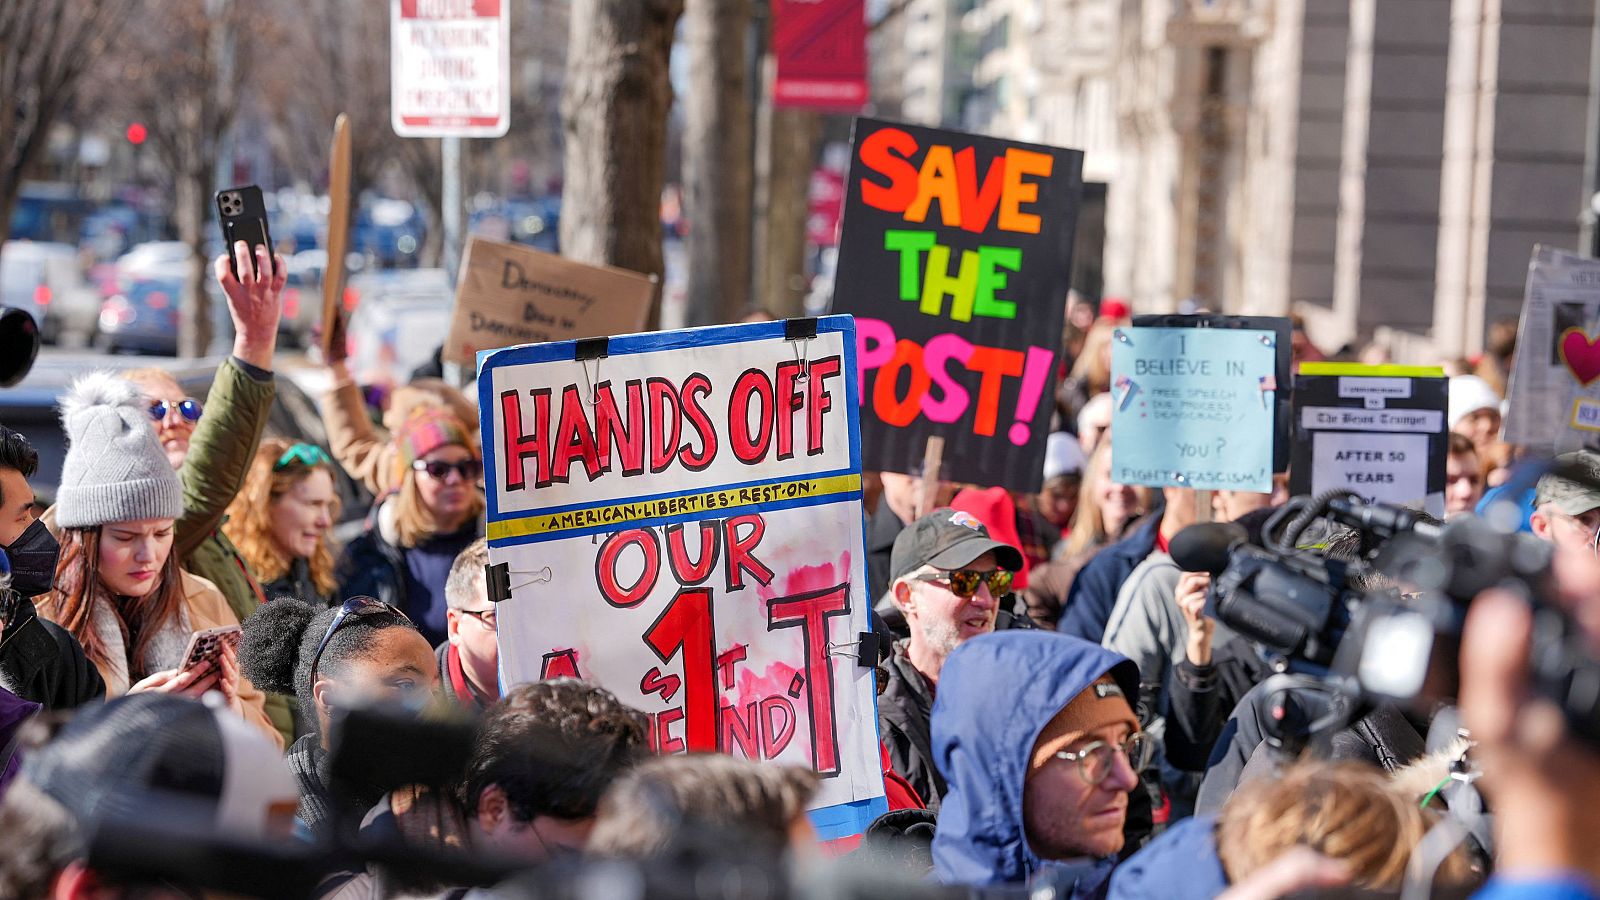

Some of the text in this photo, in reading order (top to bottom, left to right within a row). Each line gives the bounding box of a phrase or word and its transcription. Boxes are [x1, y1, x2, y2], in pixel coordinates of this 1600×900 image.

[859, 128, 1054, 234] SAVE
[884, 230, 1023, 322] THE
[855, 317, 1054, 446] POST!
[1135, 359, 1245, 376] BELIEVE IN
[501, 355, 842, 492] HANDS OFF
[1317, 413, 1337, 425] The
[1335, 451, 1405, 462] AFTER 50
[1346, 473, 1394, 483] YEARS
[595, 513, 775, 608] OUR
